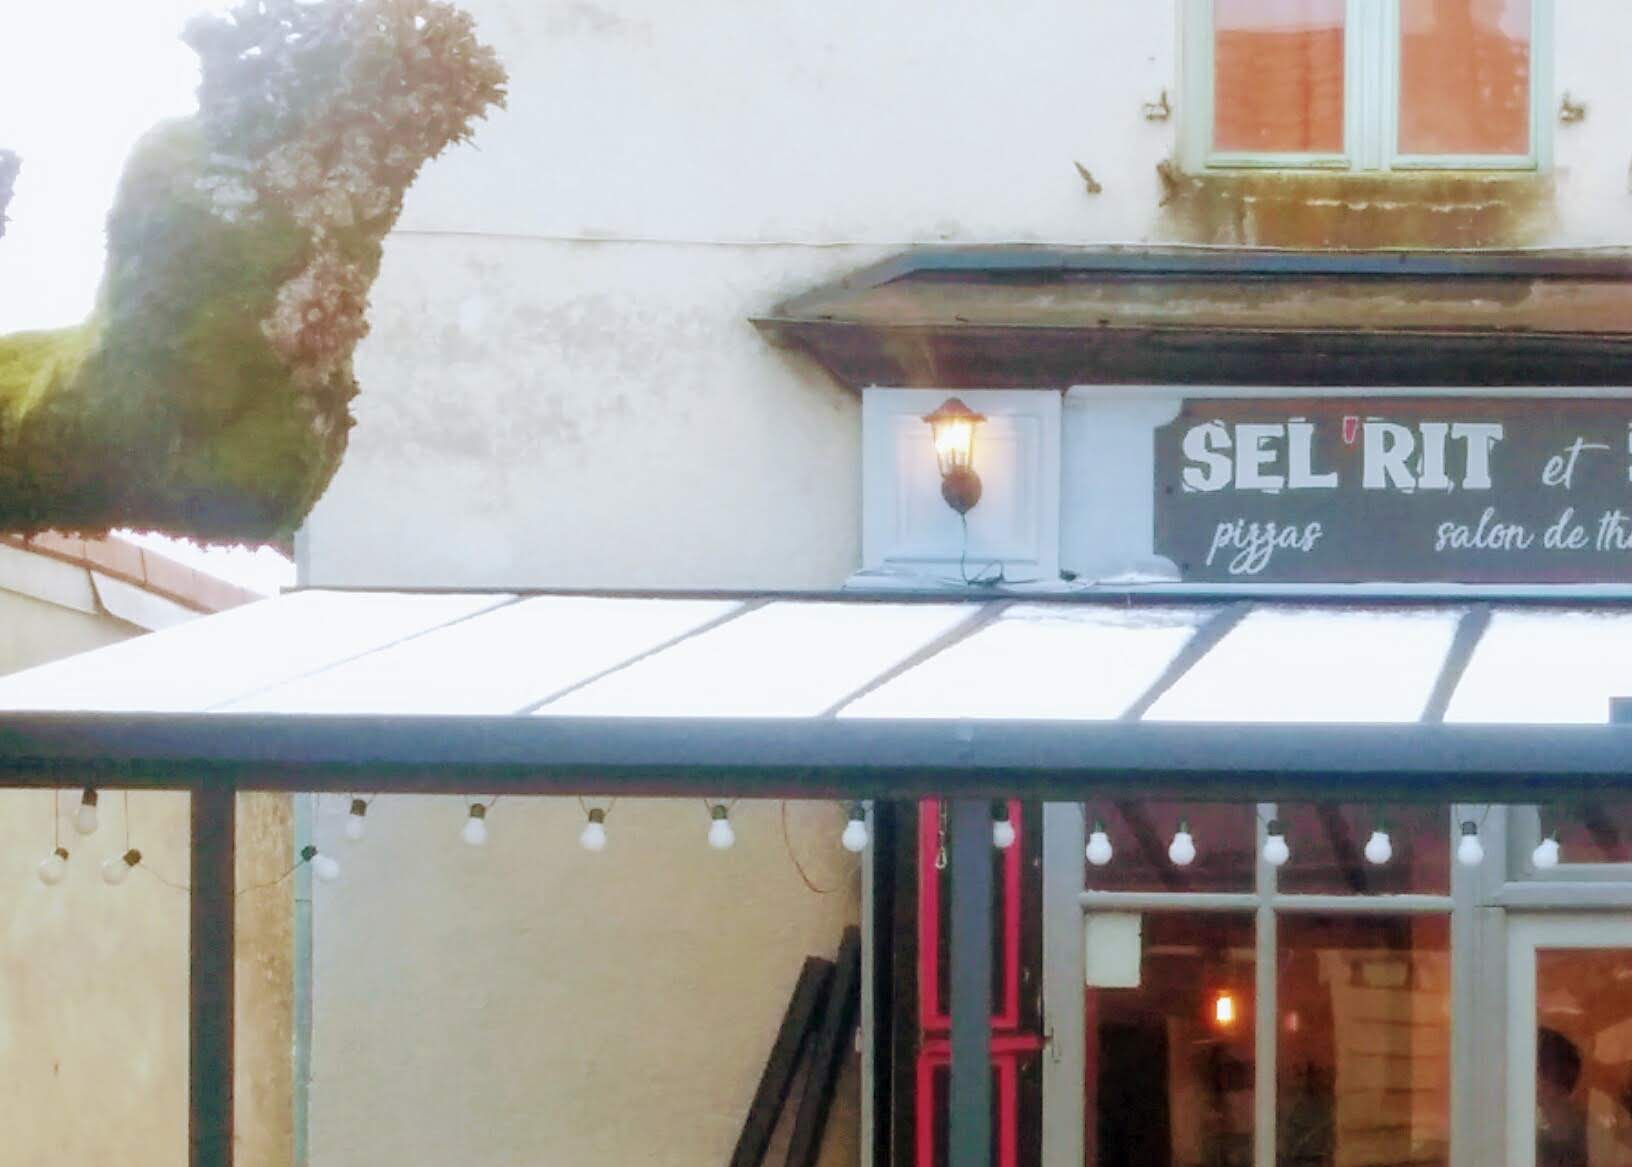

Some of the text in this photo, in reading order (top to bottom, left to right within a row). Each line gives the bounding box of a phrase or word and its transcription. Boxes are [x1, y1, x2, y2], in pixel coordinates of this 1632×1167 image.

[1542, 437, 1610, 490] et
[1206, 517, 1323, 575] pizzas
[1435, 506, 1534, 551] salon
[1543, 506, 1590, 549] de
